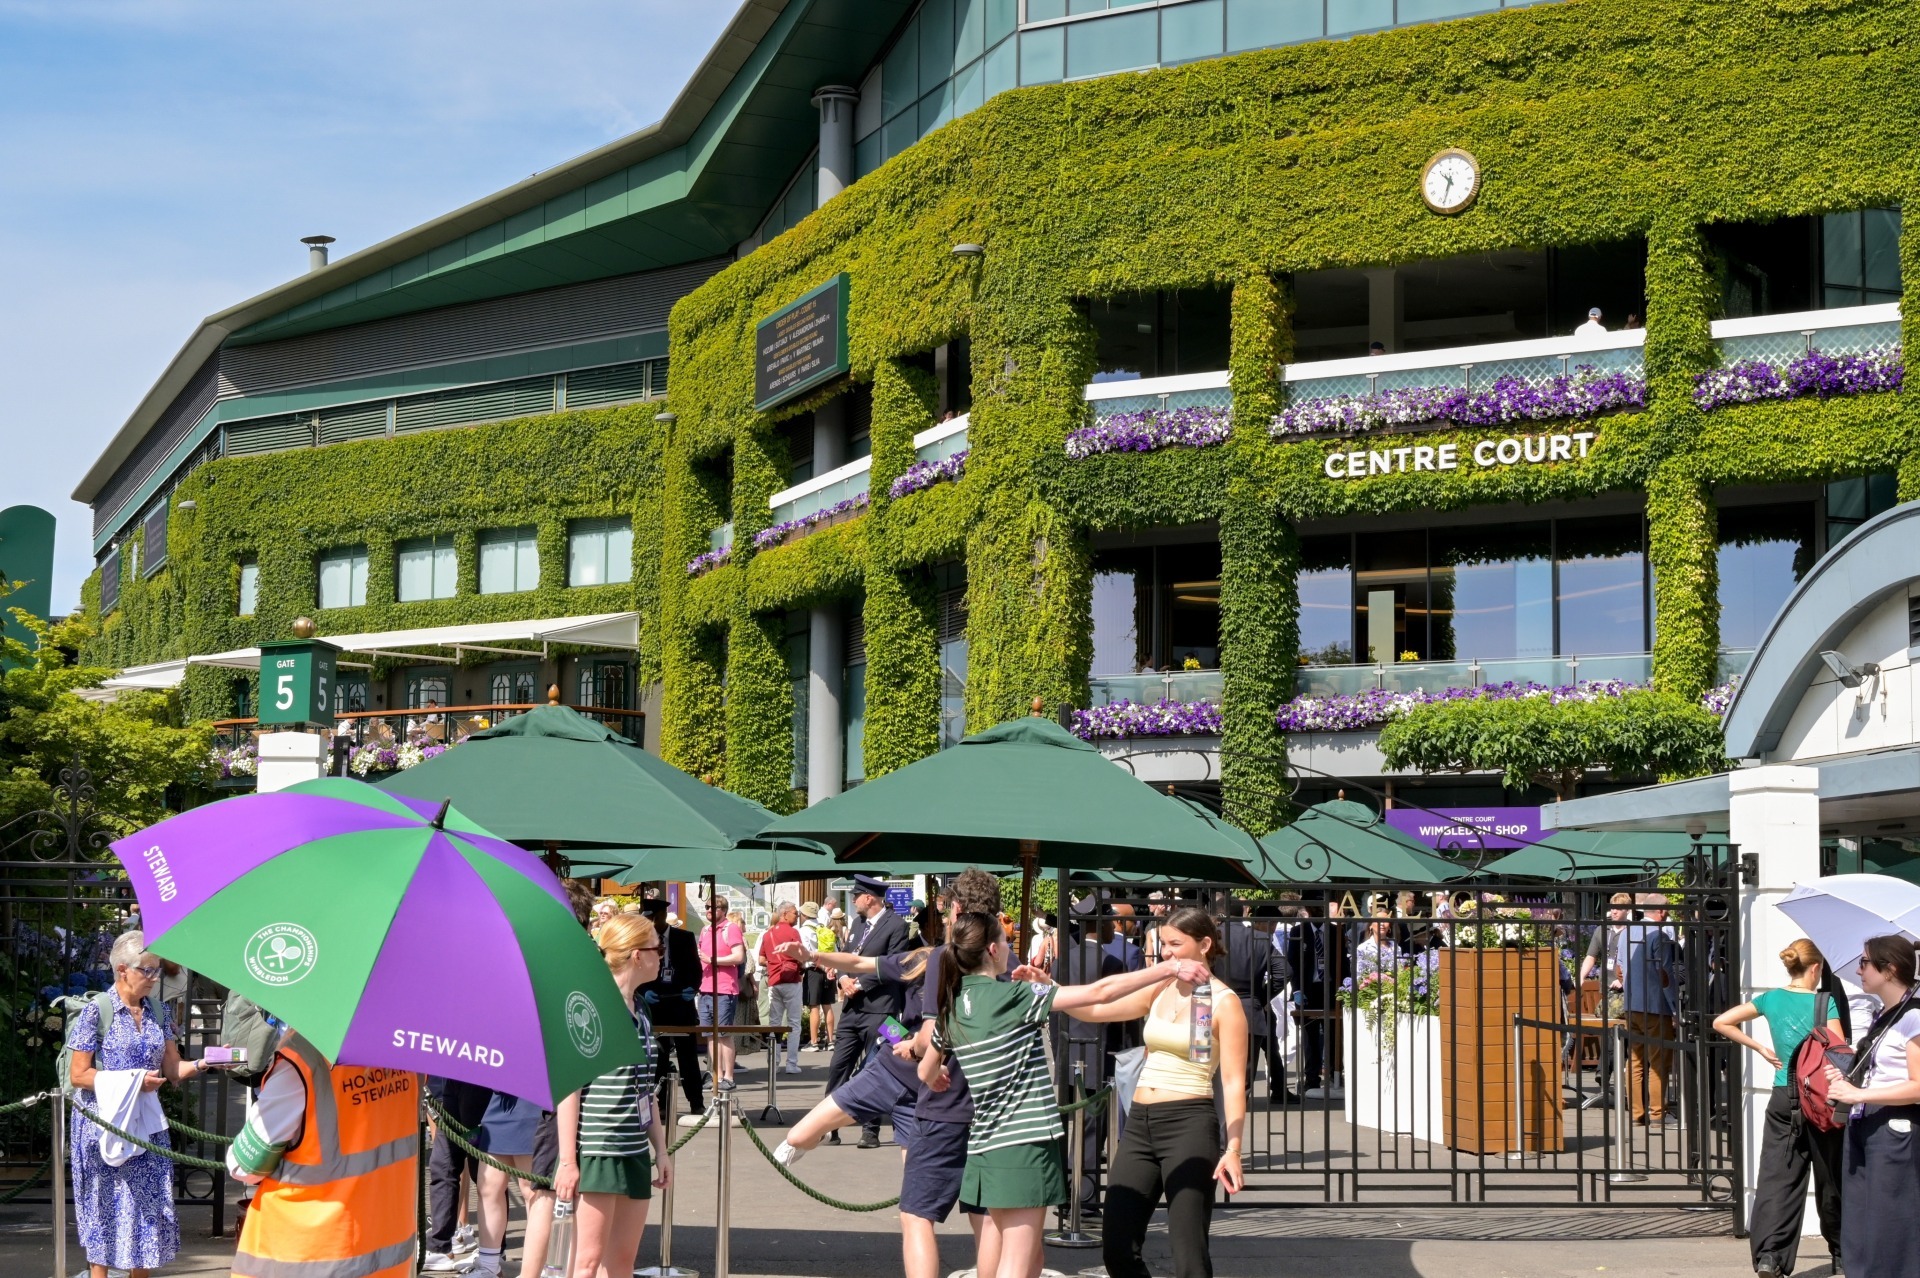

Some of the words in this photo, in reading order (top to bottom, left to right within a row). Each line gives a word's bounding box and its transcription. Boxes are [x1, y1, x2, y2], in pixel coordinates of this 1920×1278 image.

[1325, 443, 1457, 478] CENTRE
[1474, 432, 1594, 466] COURT
[276, 659, 295, 668] GATE
[276, 675, 294, 710] 5
[317, 676, 327, 712] 5
[1495, 825, 1528, 835] SHOP
[143, 845, 177, 902] STEWARD
[257, 928, 274, 940] THE
[274, 926, 314, 967] CHAMPIONSHIPS
[248, 956, 289, 982] WIMBLEDON
[392, 1029, 504, 1068] STEWARD
[352, 1078, 410, 1106] STEWARD
